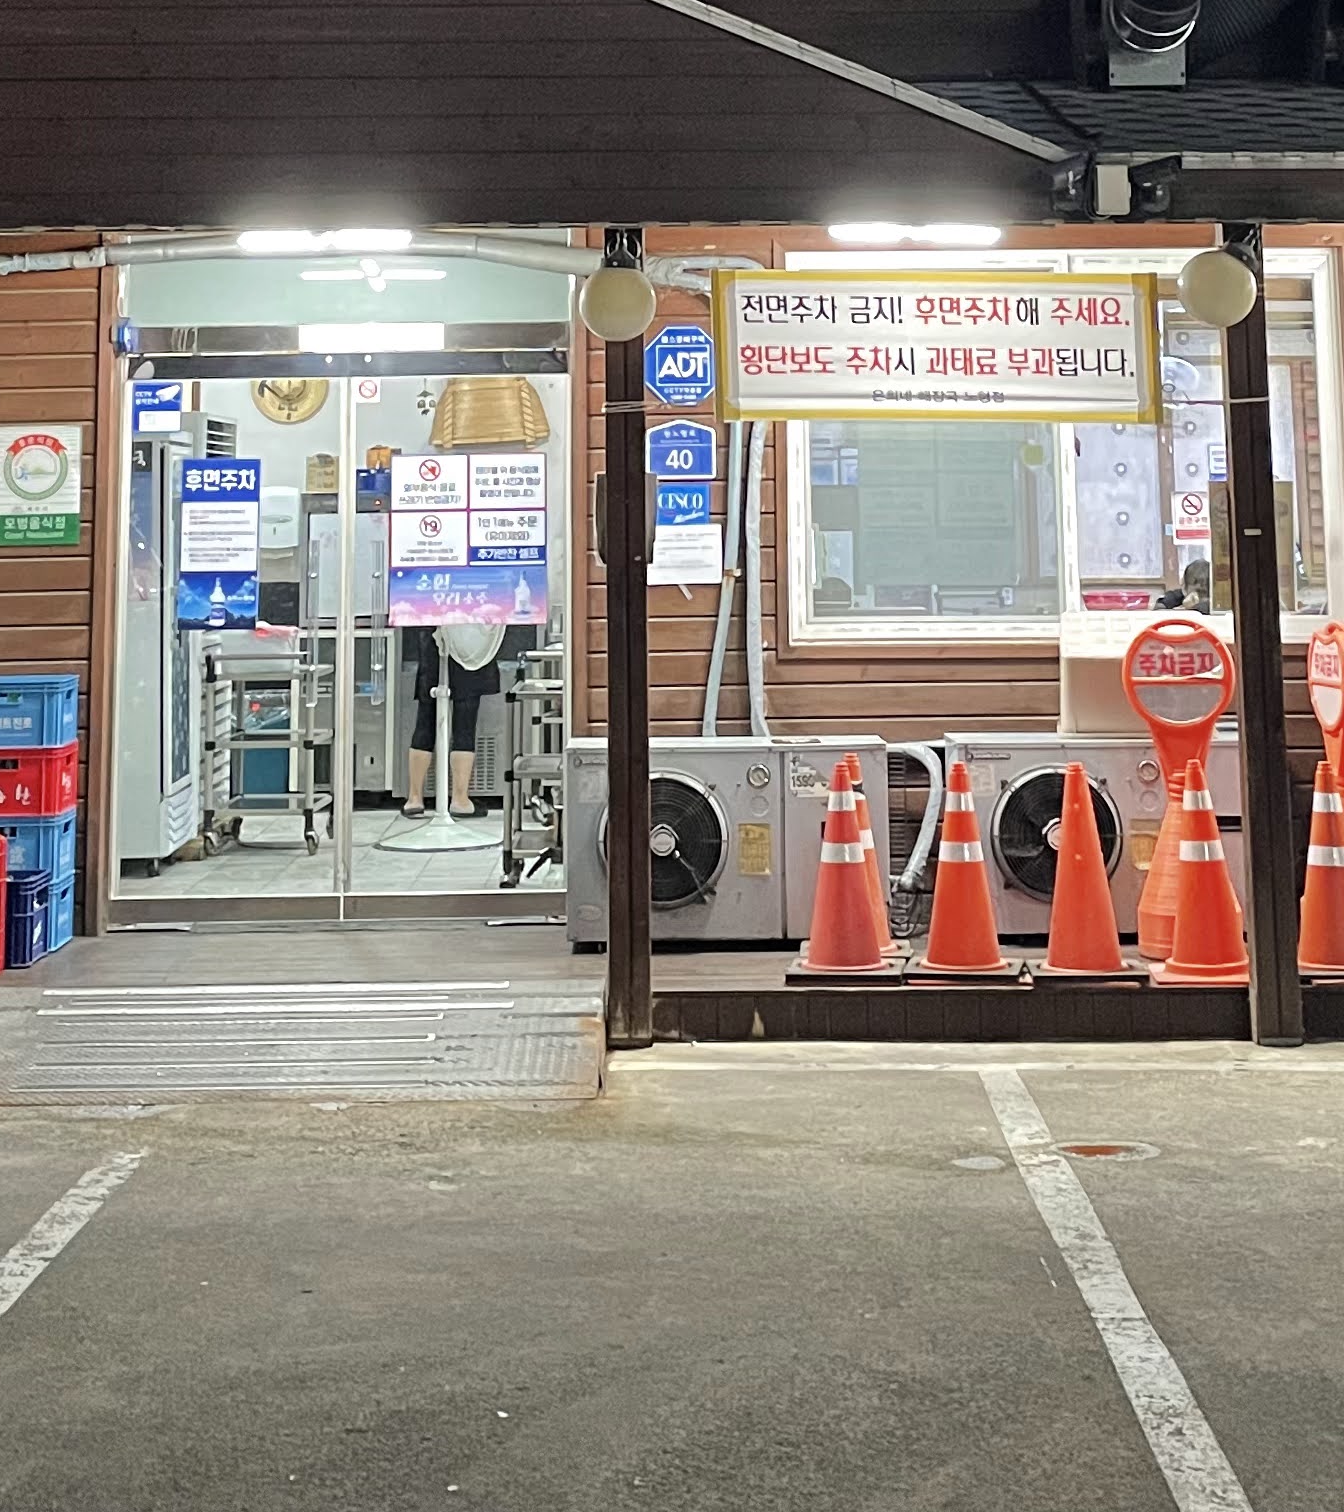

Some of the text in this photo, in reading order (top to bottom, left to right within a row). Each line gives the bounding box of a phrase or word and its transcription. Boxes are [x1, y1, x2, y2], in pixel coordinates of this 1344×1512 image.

[740, 294, 838, 325] 전면주차
[848, 294, 904, 325] 금지!
[1050, 296, 1132, 327] 주세요.
[658, 351, 708, 378] ADT
[739, 344, 1136, 379] 횡단보도 주차시 과태료 부과됩니다.
[665, 449, 694, 470] 40
[185, 469, 256, 492] 후면주차
[658, 492, 704, 510] CESCO
[4, 516, 66, 530] 모범음식점
[1139, 653, 1215, 677] 주차금지
